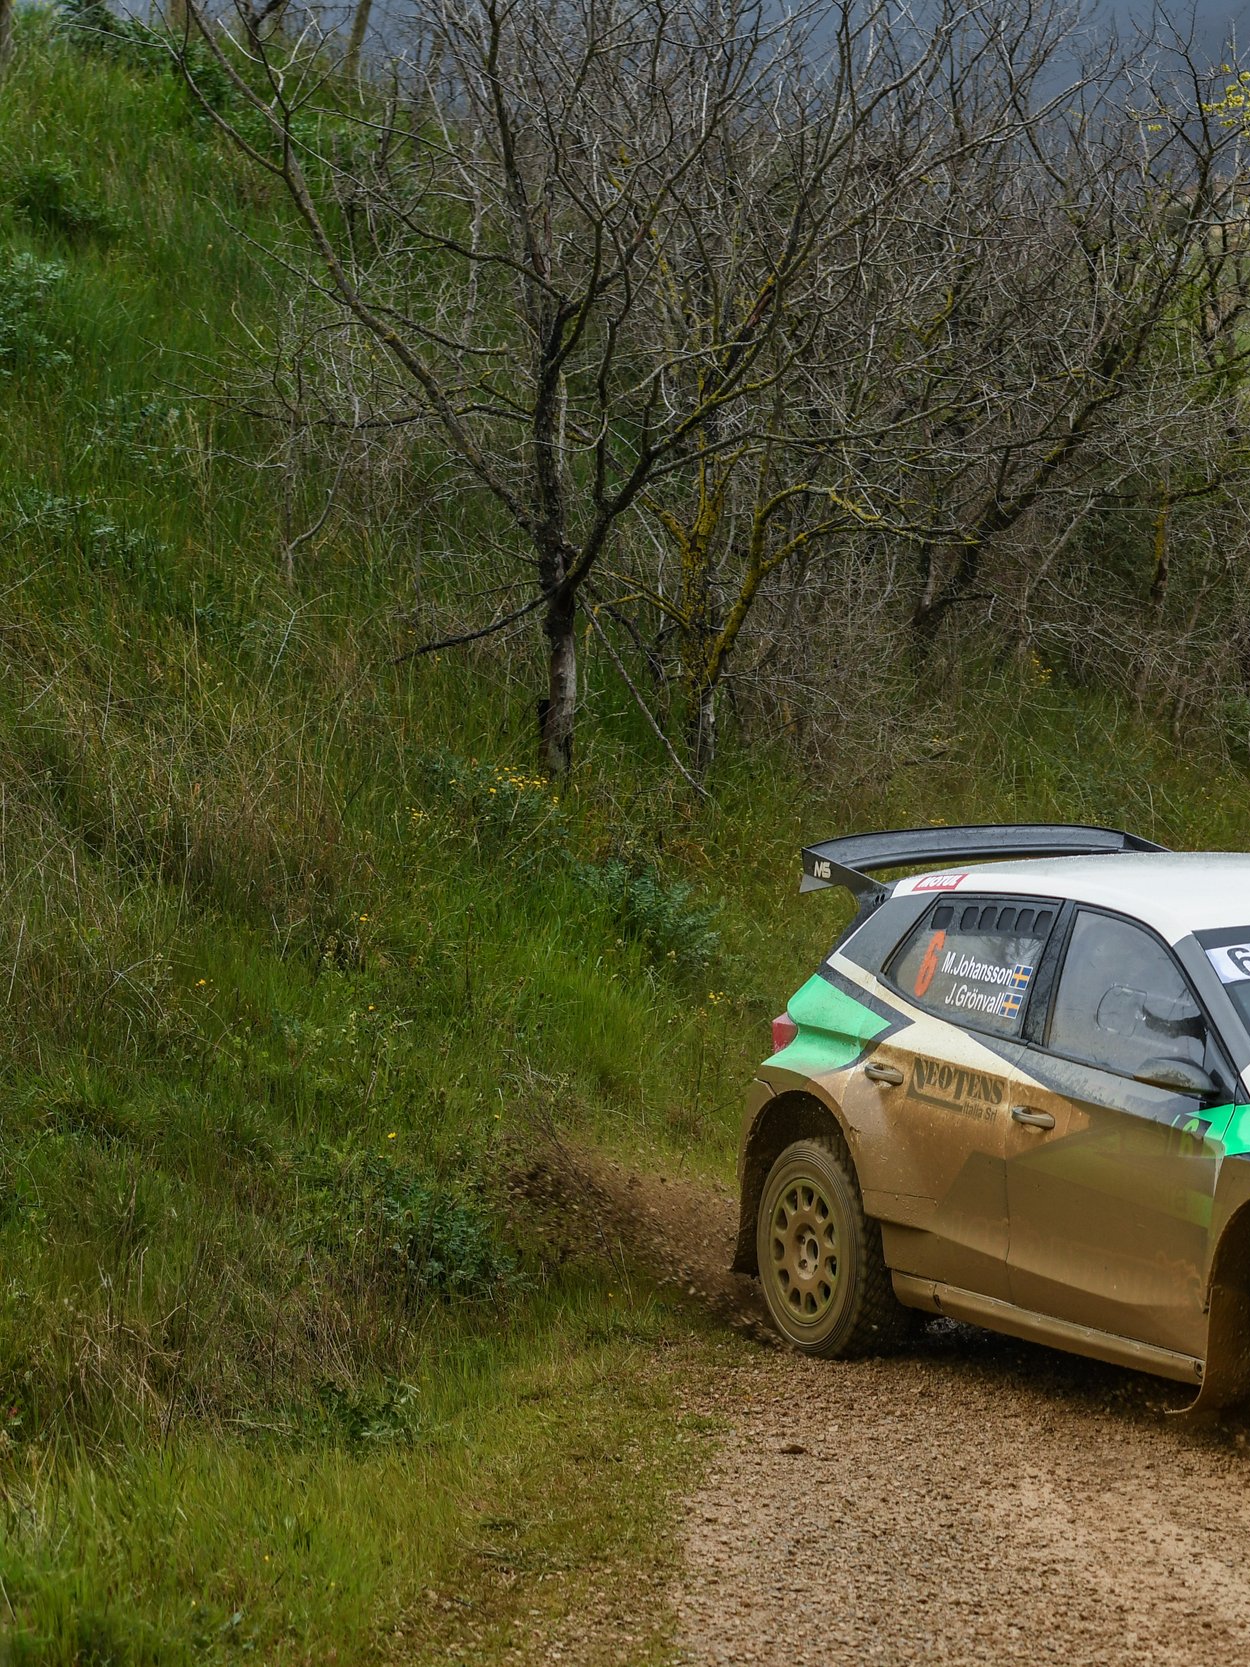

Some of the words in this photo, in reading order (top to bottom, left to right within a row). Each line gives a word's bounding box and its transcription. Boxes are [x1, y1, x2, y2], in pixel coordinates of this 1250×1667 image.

[814, 860, 831, 879] MS
[917, 874, 962, 888] MOTUL
[914, 930, 946, 998] 6
[941, 951, 1013, 986] M.Johansson
[945, 983, 1005, 1015] J.Grönvall
[913, 1056, 1004, 1105] NEOTENS
[962, 1101, 984, 1119] Italia
[985, 1106, 999, 1122] Srl
